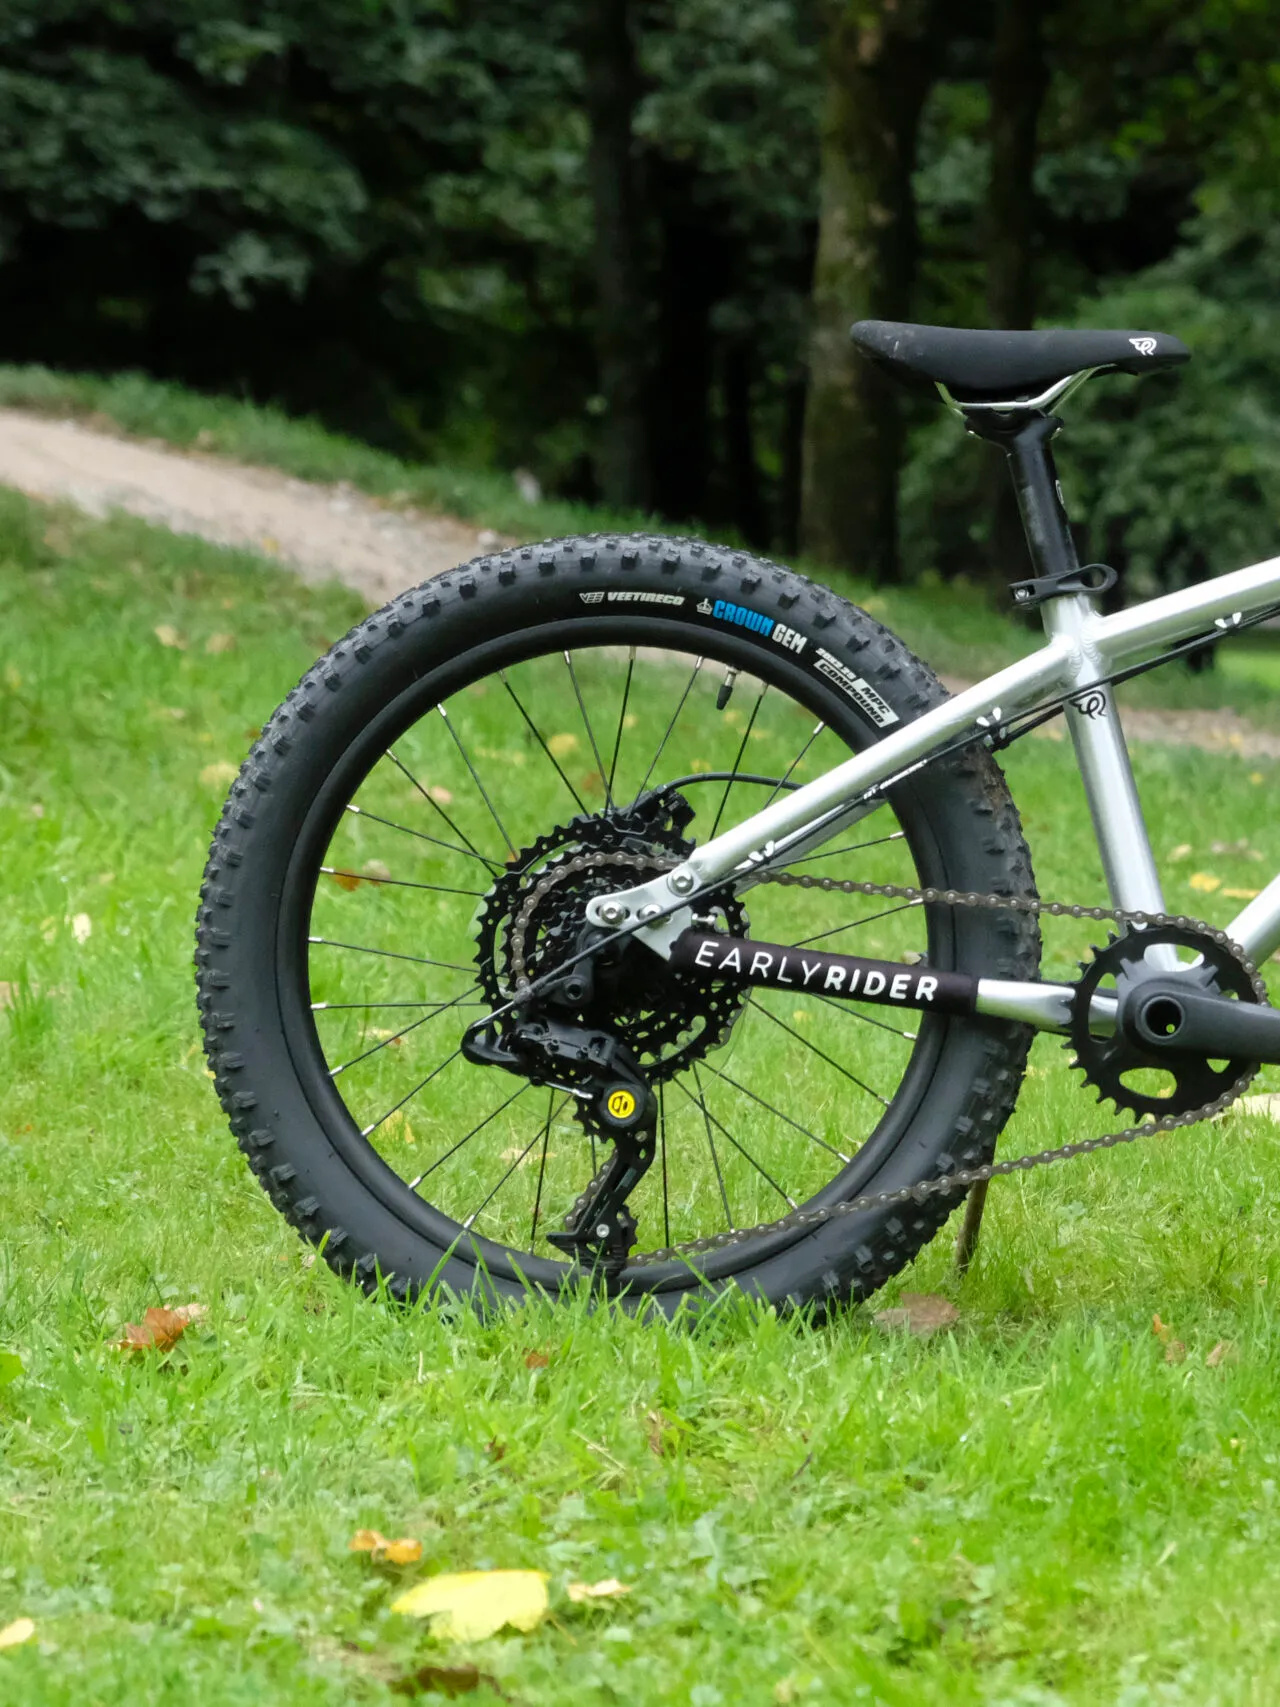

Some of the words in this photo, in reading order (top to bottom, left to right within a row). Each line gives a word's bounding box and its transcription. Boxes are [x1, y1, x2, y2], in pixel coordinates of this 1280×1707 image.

[713, 600, 775, 637] CROWN
[772, 623, 808, 655] GEM
[819, 663, 884, 723] COMPOUND
[861, 687, 890, 714] MPC
